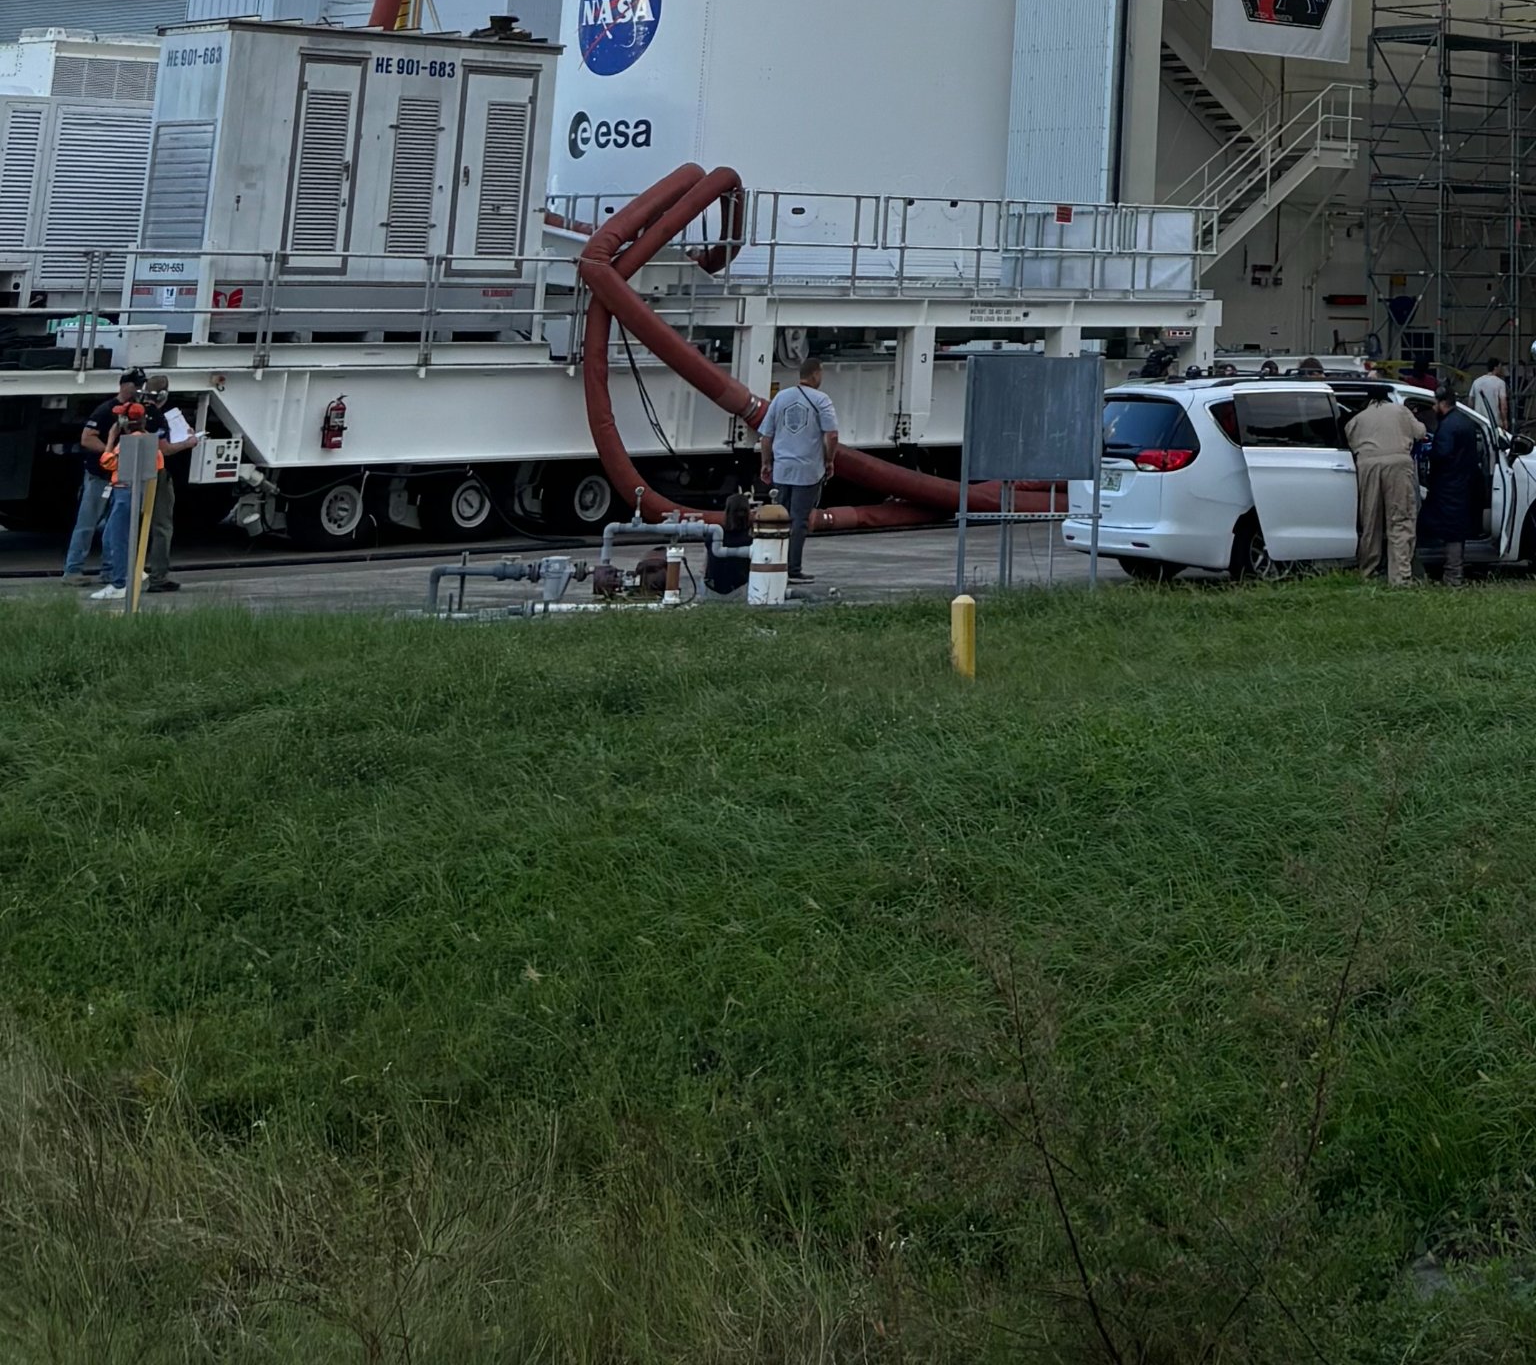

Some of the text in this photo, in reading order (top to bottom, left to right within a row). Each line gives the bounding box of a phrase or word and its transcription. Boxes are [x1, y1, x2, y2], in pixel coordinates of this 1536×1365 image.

[166, 46, 222, 67] HE 901-683
[375, 57, 456, 78] HE 901-683
[594, 119, 652, 149] esa
[758, 354, 765, 365] 4
[920, 353, 928, 364] 3
